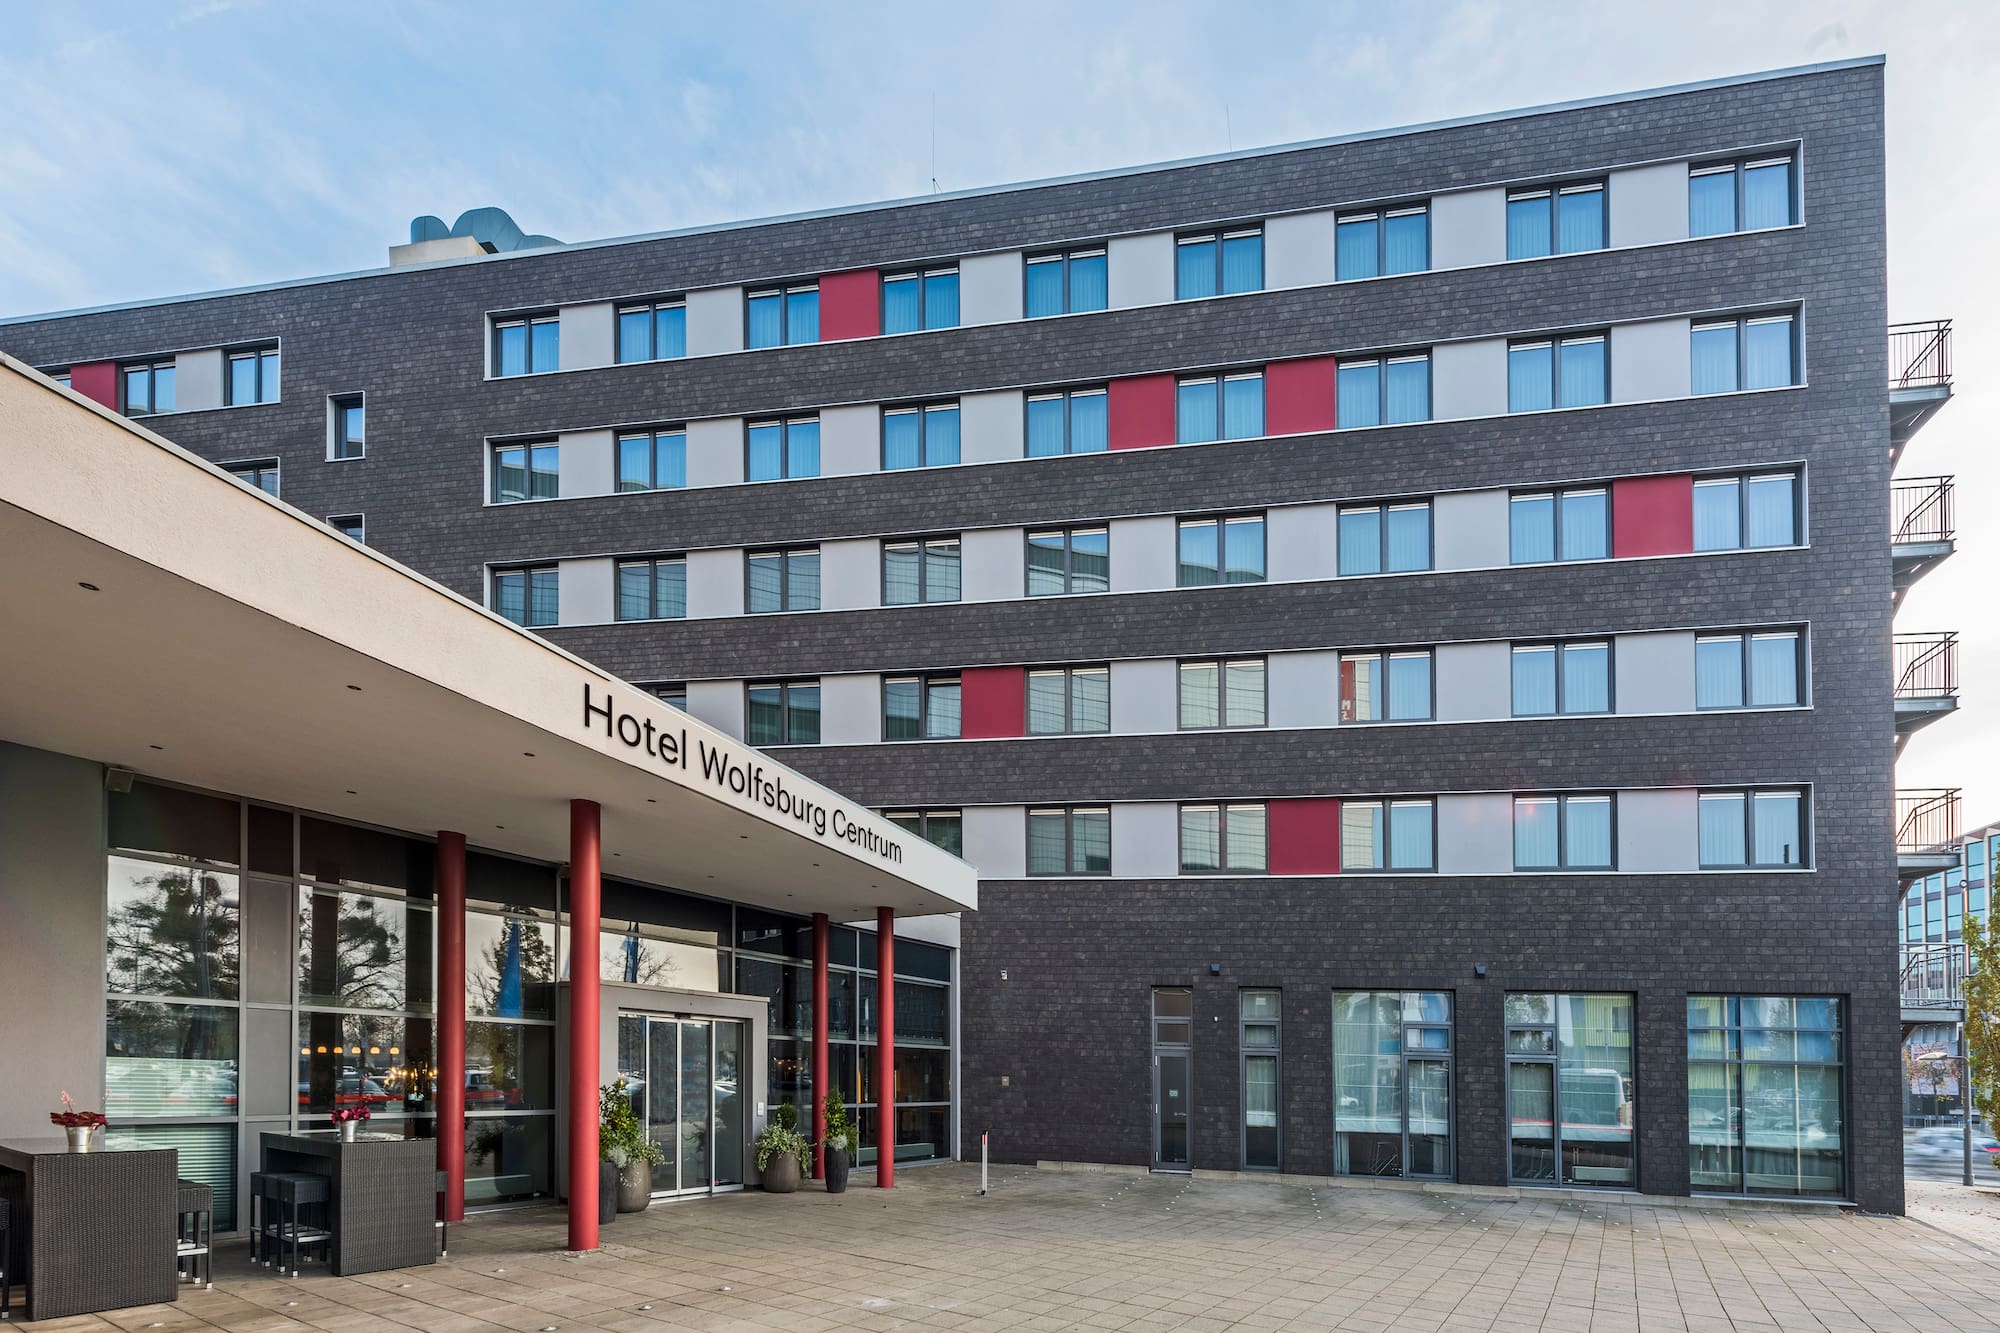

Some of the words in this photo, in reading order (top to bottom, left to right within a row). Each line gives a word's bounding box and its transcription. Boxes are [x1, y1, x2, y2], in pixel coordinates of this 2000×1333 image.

[584, 683, 687, 769] Hotel
[699, 740, 826, 836] Wolfsburg
[832, 809, 902, 864] Centrum
